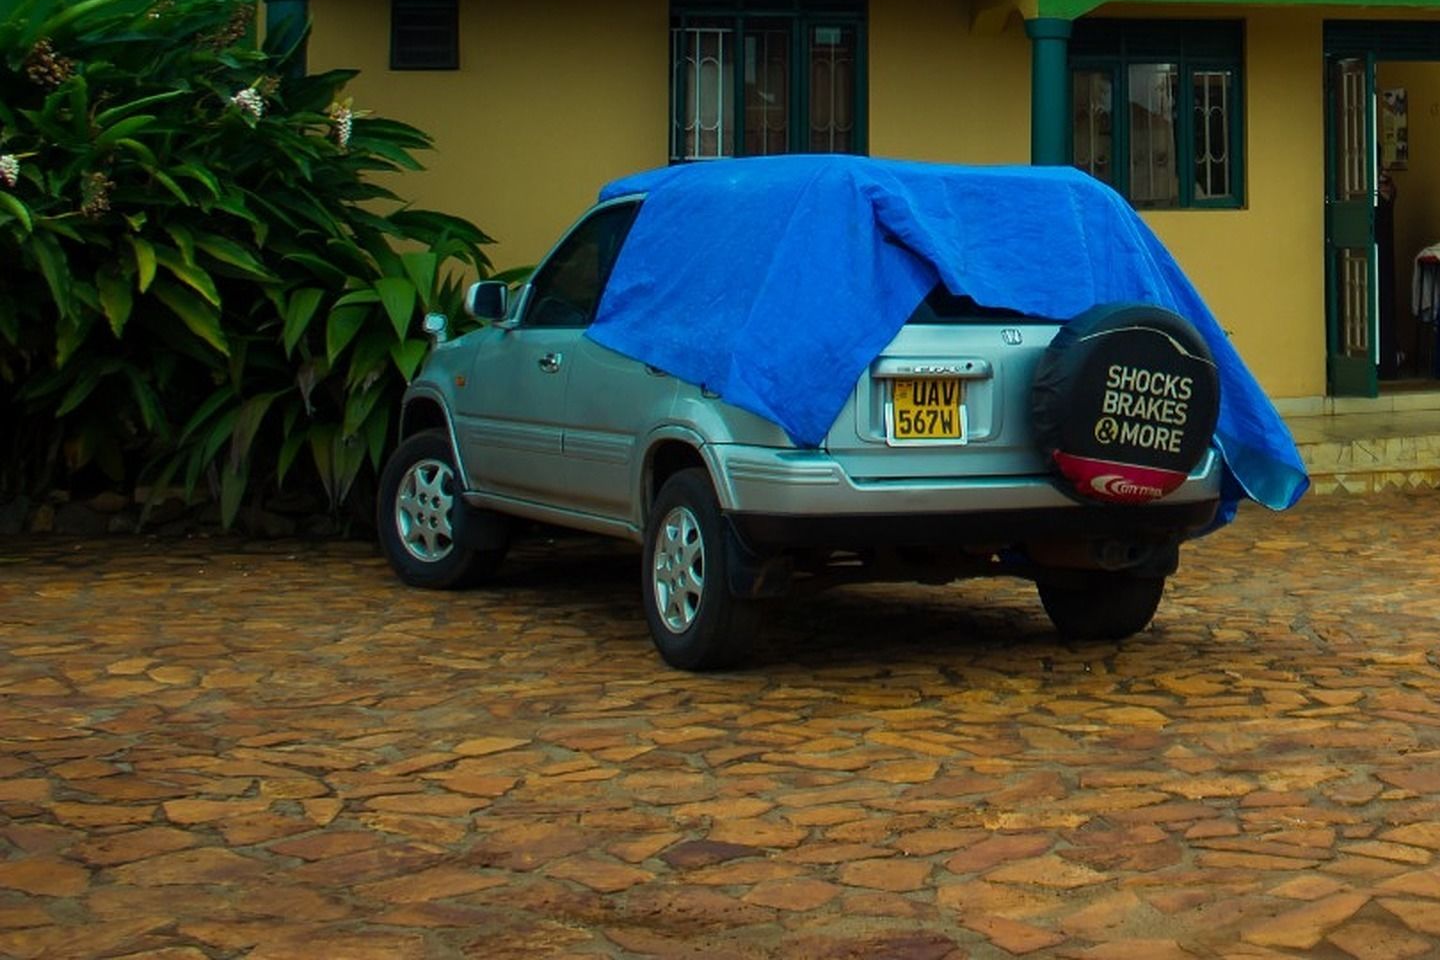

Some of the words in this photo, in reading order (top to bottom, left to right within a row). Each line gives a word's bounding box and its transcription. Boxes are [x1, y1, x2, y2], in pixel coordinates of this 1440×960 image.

[913, 381, 955, 407] UAV
[1106, 365, 1193, 400] SHOCKS
[898, 409, 953, 435] 567W
[1102, 390, 1188, 425] BRAKES
